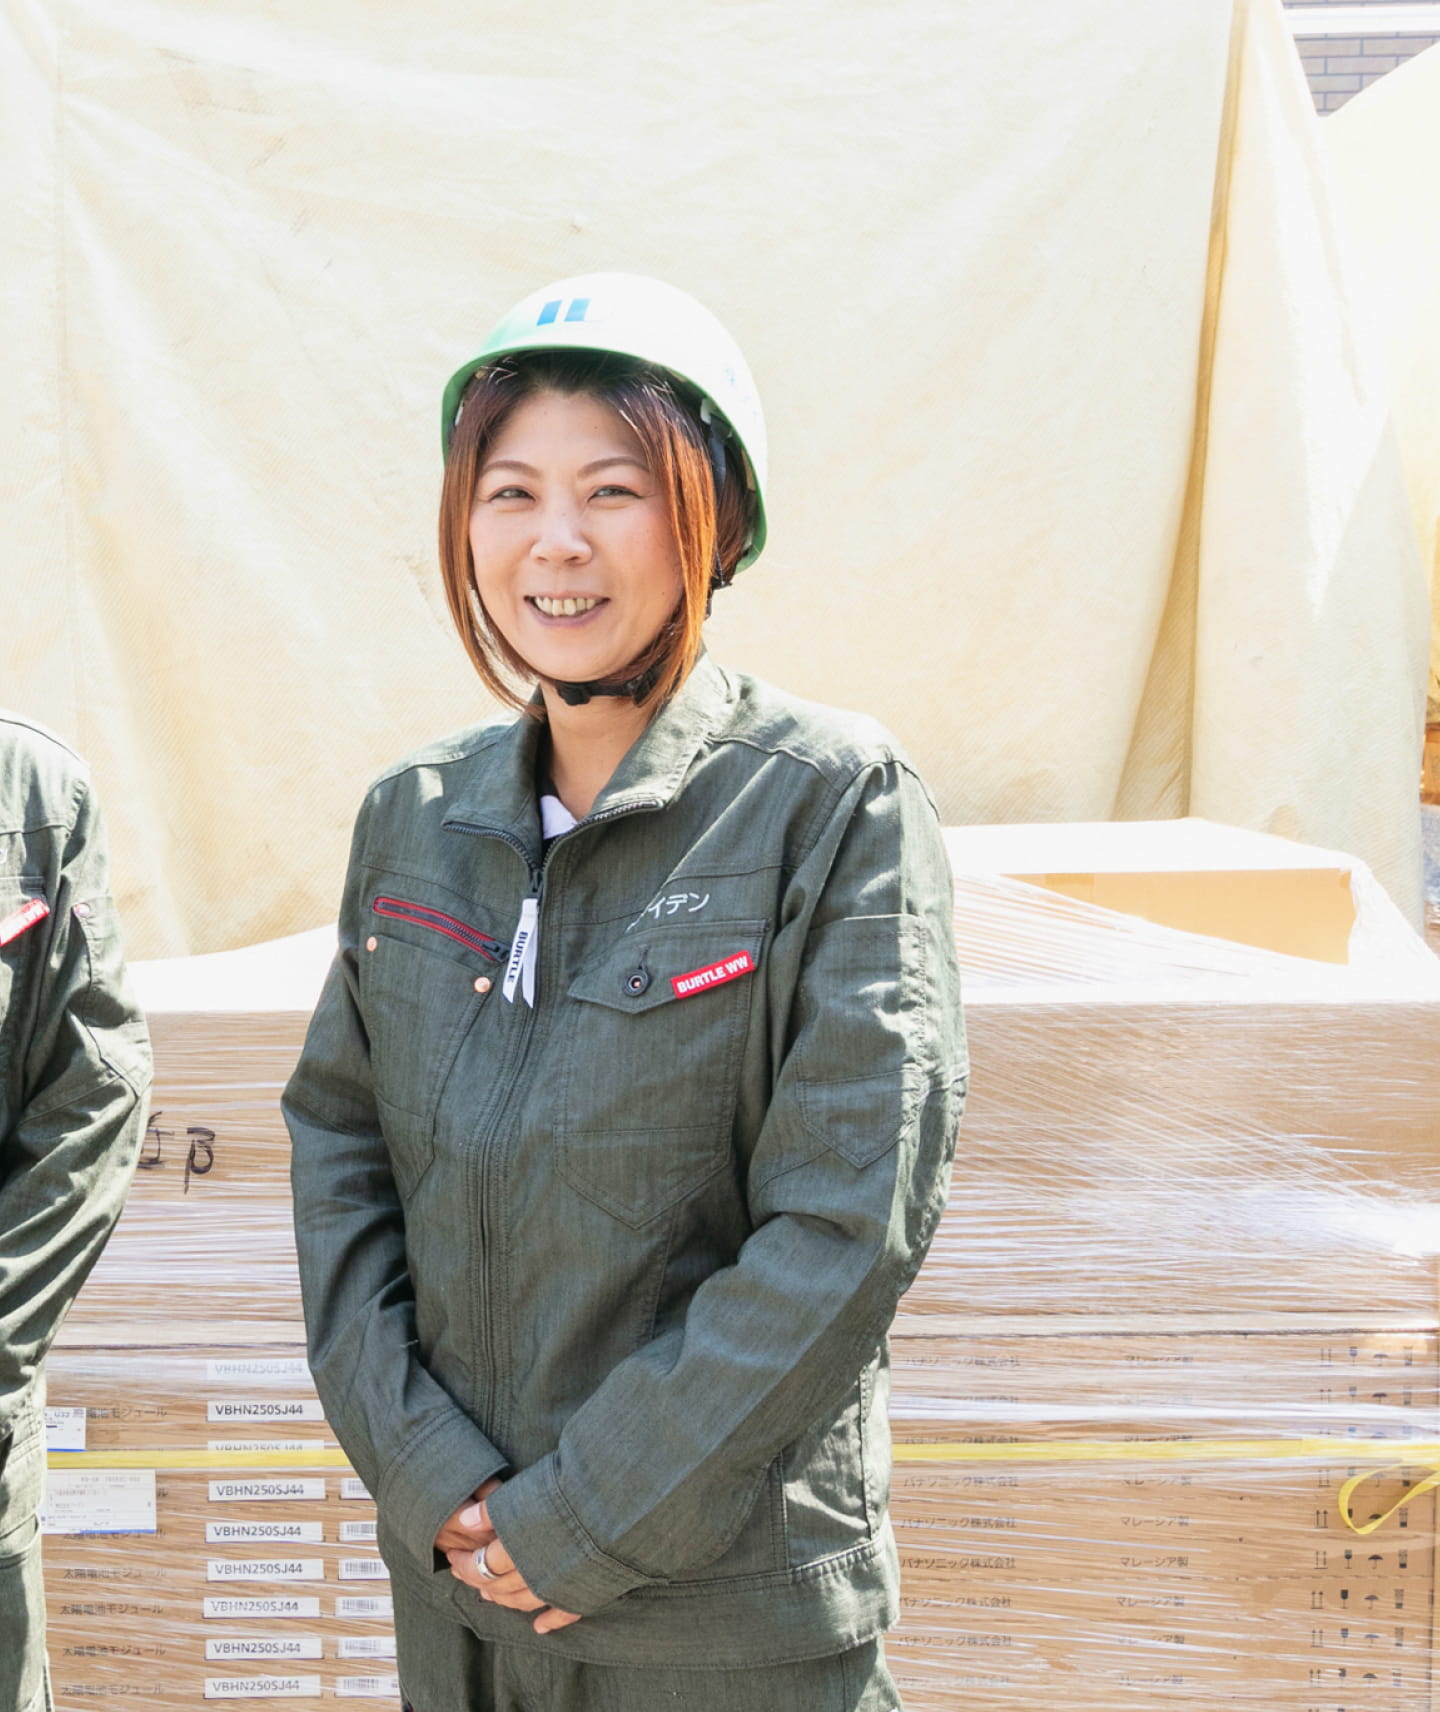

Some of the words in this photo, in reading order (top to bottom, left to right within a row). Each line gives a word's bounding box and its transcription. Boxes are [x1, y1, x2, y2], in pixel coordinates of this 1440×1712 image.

[506, 930, 529, 984] BURTLE
[676, 965, 726, 994] BURTLE
[724, 955, 750, 975] WW
[215, 1404, 304, 1415] VBHN250SJ44
[216, 1484, 304, 1496] VBHN250SJ44
[213, 1525, 301, 1536] VBHN250SJ44
[215, 1563, 303, 1574] VBHN250SJ44
[211, 1601, 299, 1612] VBHN250SJ44
[214, 1642, 301, 1654] VBHN250SJ44
[212, 1680, 300, 1692] VBHN250SJ44
